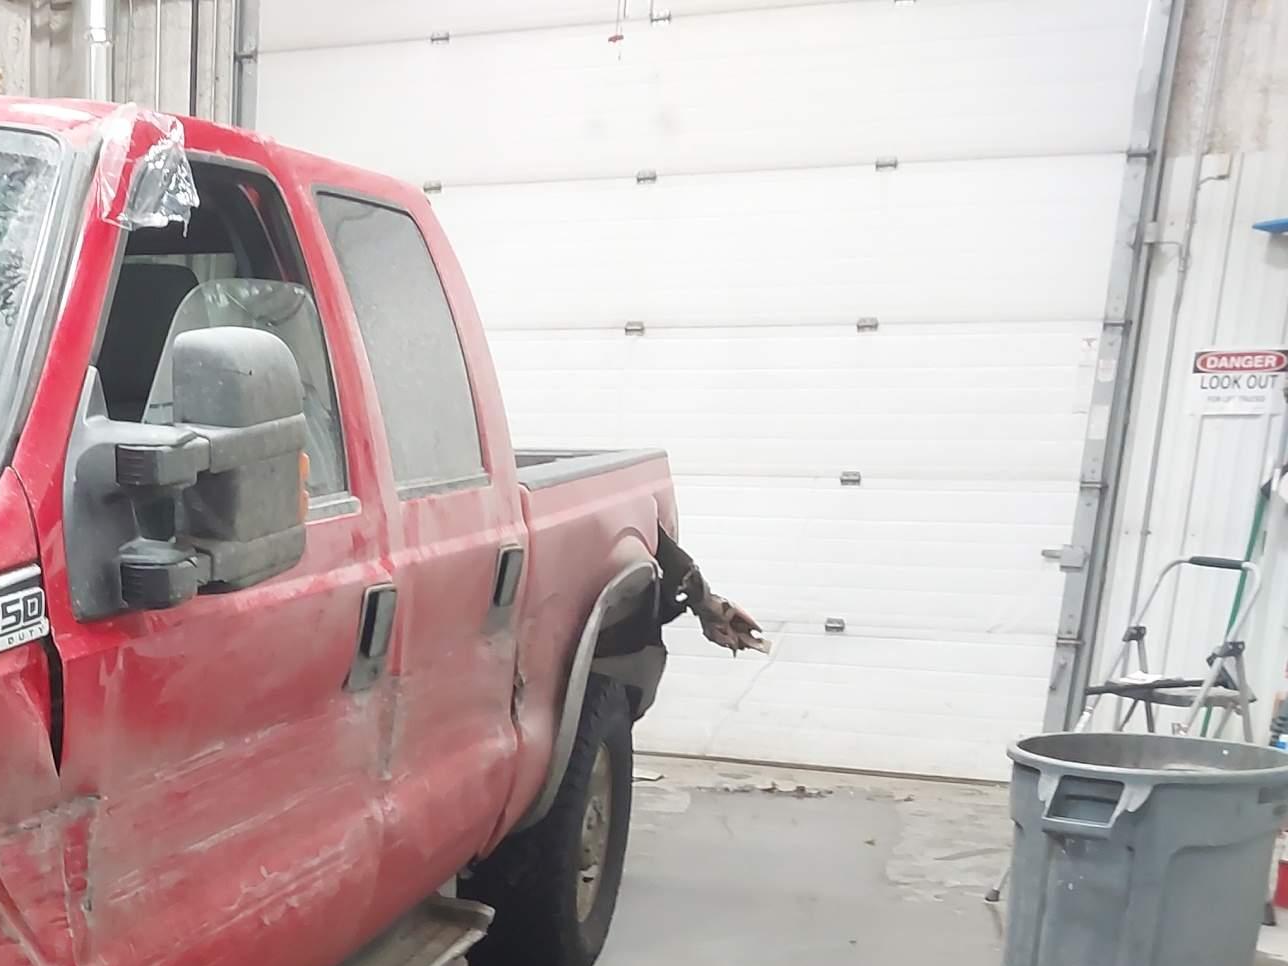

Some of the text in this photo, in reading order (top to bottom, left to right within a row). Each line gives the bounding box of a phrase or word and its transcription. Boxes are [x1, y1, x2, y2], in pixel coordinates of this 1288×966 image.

[1206, 355, 1278, 369] DANGER
[1200, 374, 1279, 390] LOOK OUT
[8, 626, 46, 645] DUTY
